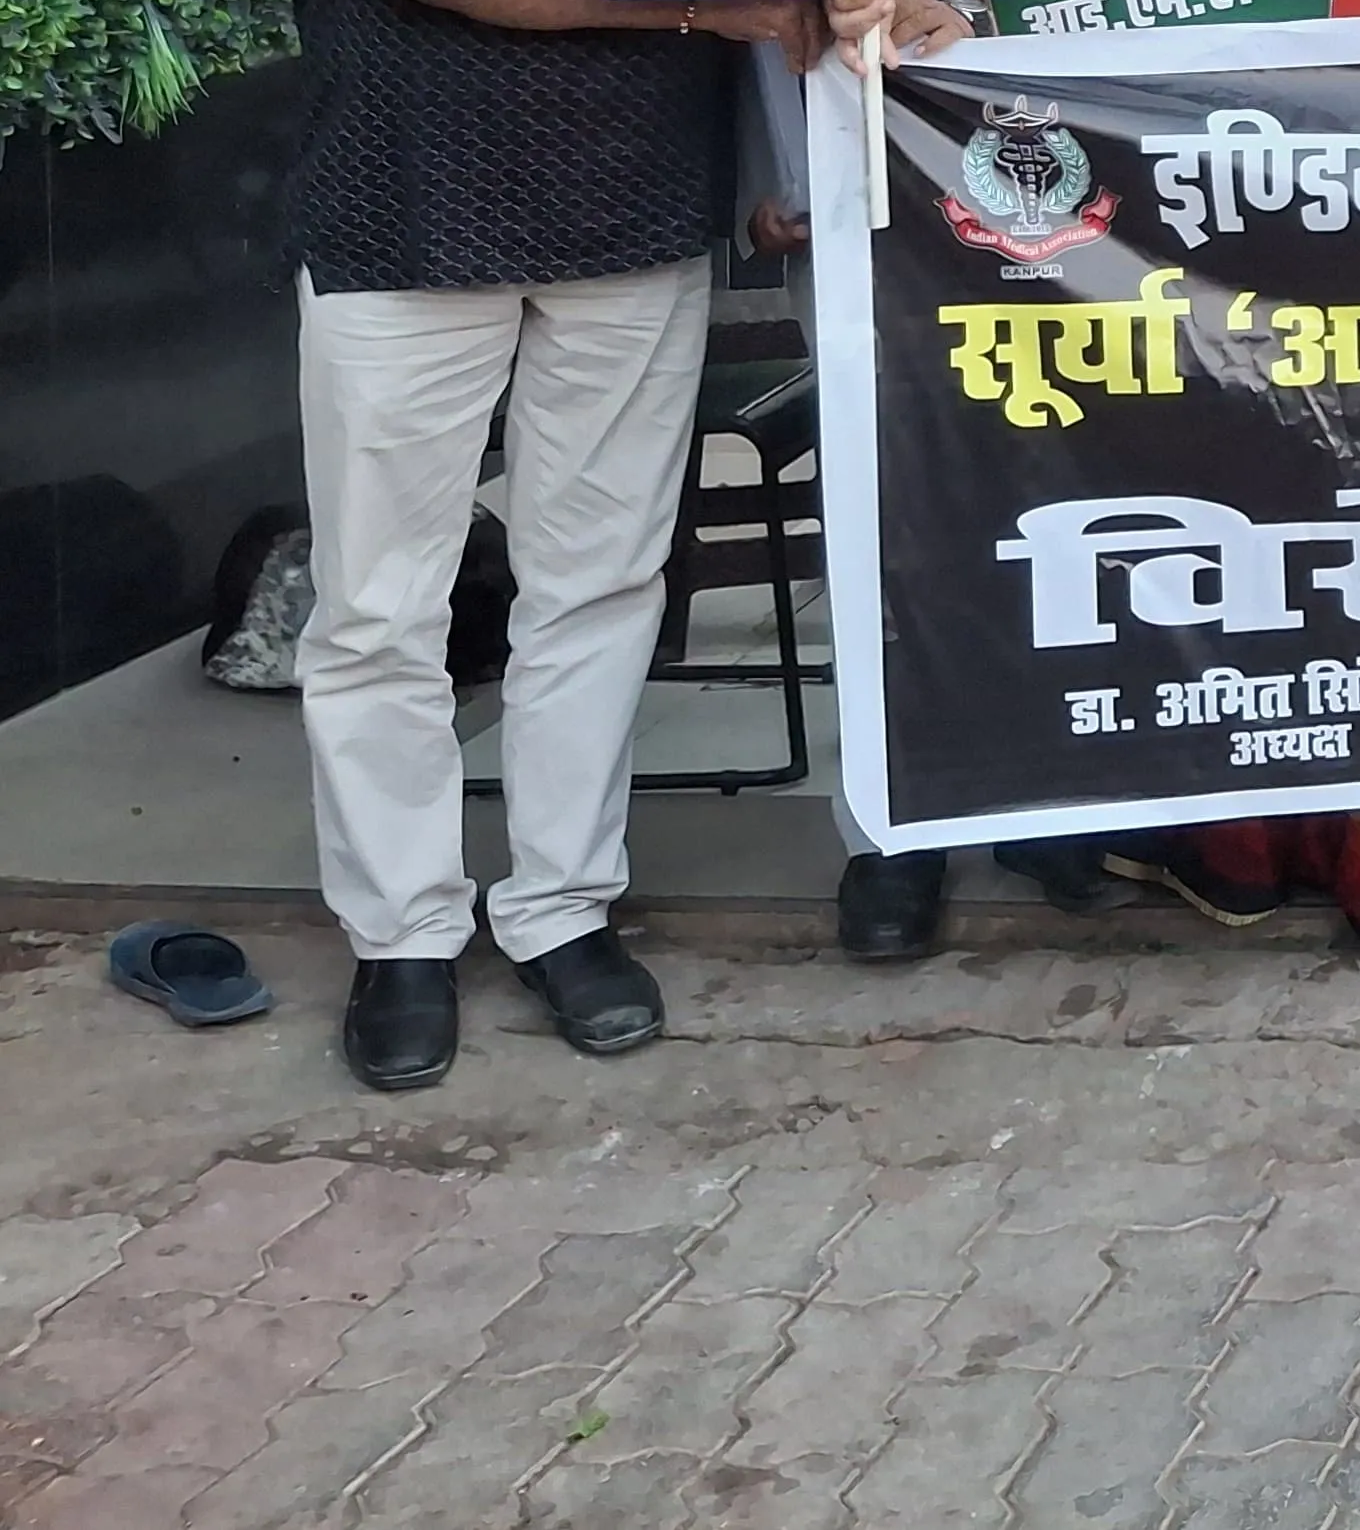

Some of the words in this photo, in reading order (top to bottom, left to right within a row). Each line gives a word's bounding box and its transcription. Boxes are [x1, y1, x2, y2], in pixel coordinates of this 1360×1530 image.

[965, 228, 998, 244] Indian
[1001, 264, 1063, 279] KANPUR
[938, 267, 1191, 429] सूर्या
[1064, 688, 1135, 734] डा.
[1156, 667, 1296, 727] अमित
